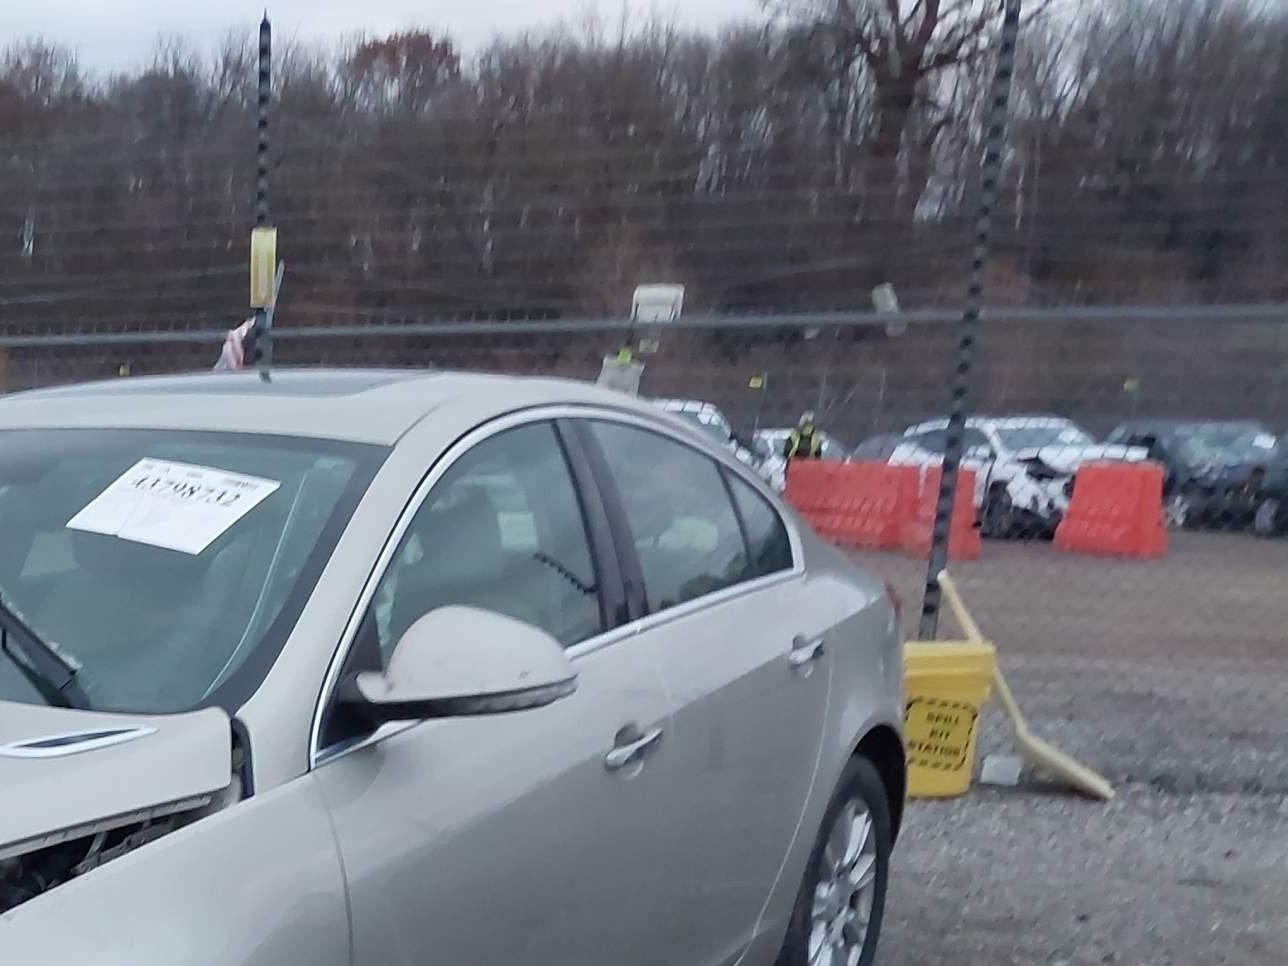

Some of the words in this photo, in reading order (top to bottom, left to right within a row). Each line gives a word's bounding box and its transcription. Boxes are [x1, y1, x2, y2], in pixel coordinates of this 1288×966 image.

[926, 711, 960, 726] SPILL
[929, 728, 951, 740] KIT
[908, 740, 961, 757] STATION
